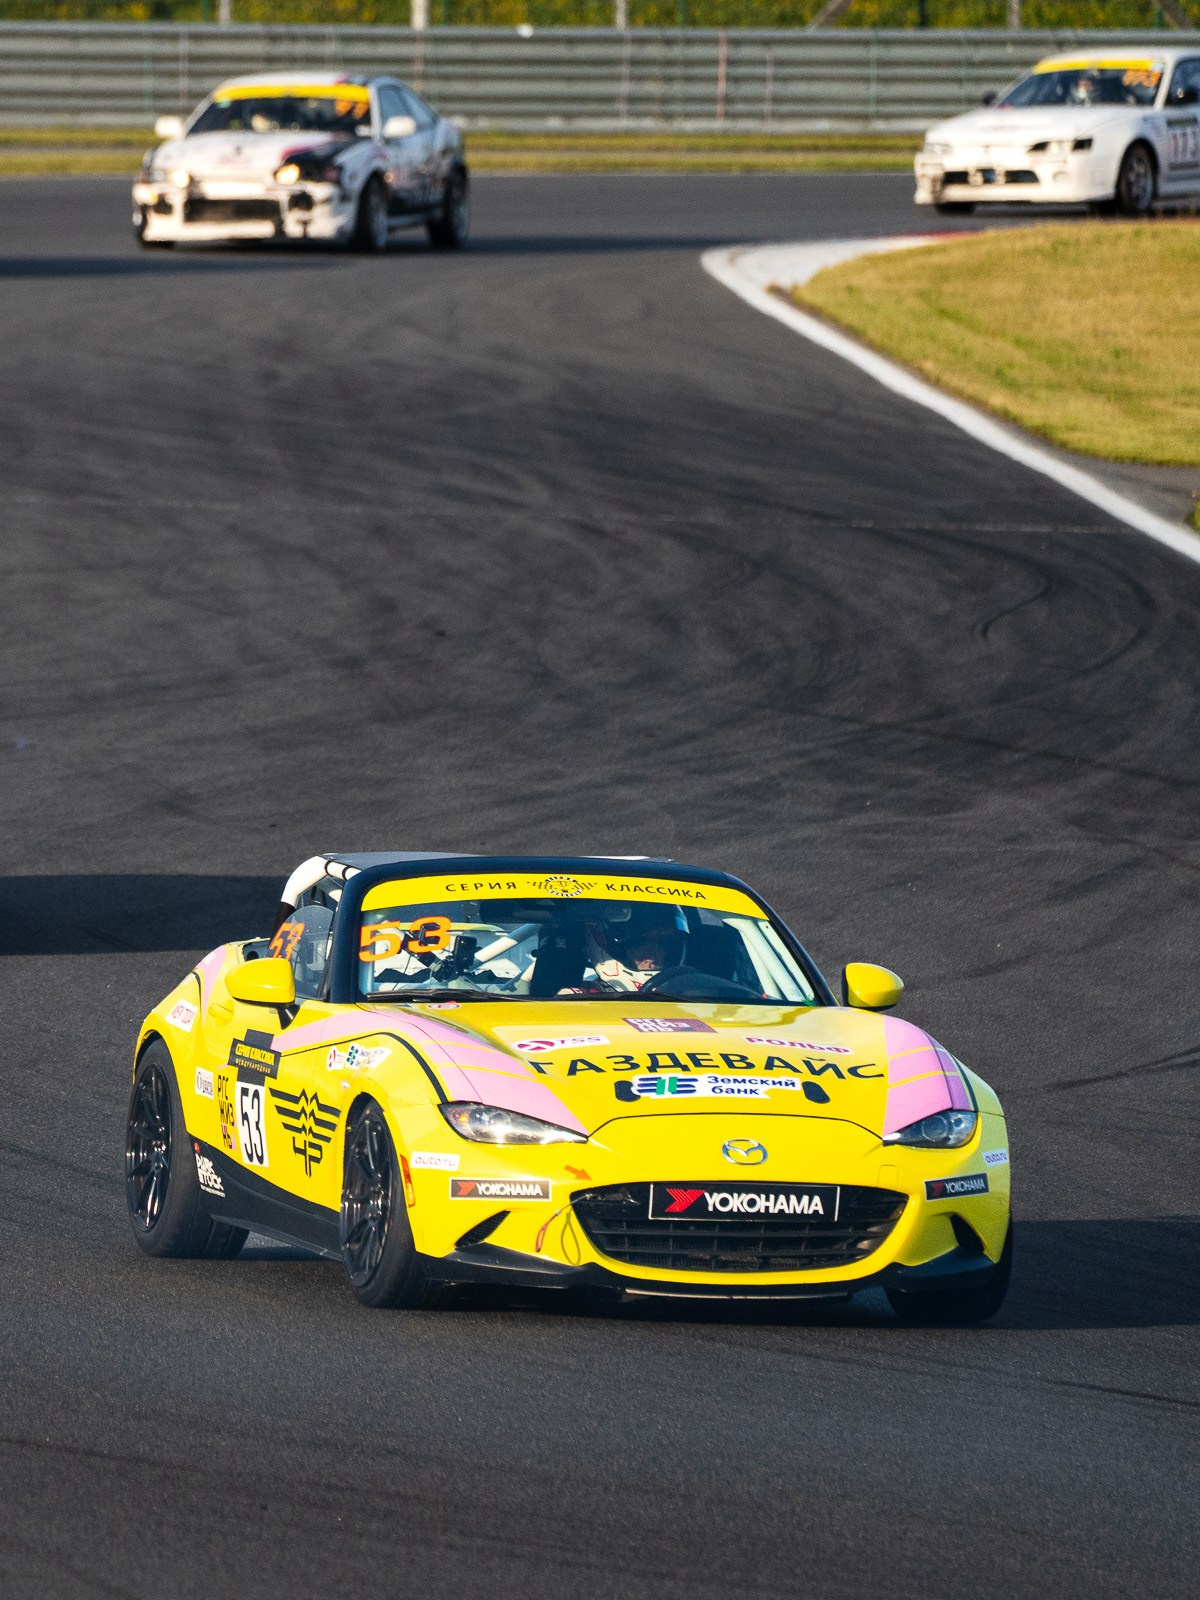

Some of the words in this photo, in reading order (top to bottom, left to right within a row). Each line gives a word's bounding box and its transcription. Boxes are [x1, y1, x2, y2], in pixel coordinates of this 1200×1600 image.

[445, 881, 517, 892] СЕРИЯ
[606, 883, 707, 900] КЛАССИКА
[266, 922, 305, 960] 53
[358, 916, 452, 963] 53
[559, 1036, 601, 1045] TSS
[745, 1037, 850, 1054] РОЛЬФ
[528, 1052, 885, 1080] ГАЗДЕВАЙС
[707, 1075, 796, 1088] Земский
[711, 1086, 760, 1096] банк
[240, 1086, 264, 1165] 53
[415, 1154, 456, 1168] auto.ru
[476, 1183, 544, 1197] YOKOHAMA
[944, 1178, 986, 1194] YOKOHAMA
[703, 1191, 824, 1215] YOKOHAMA
